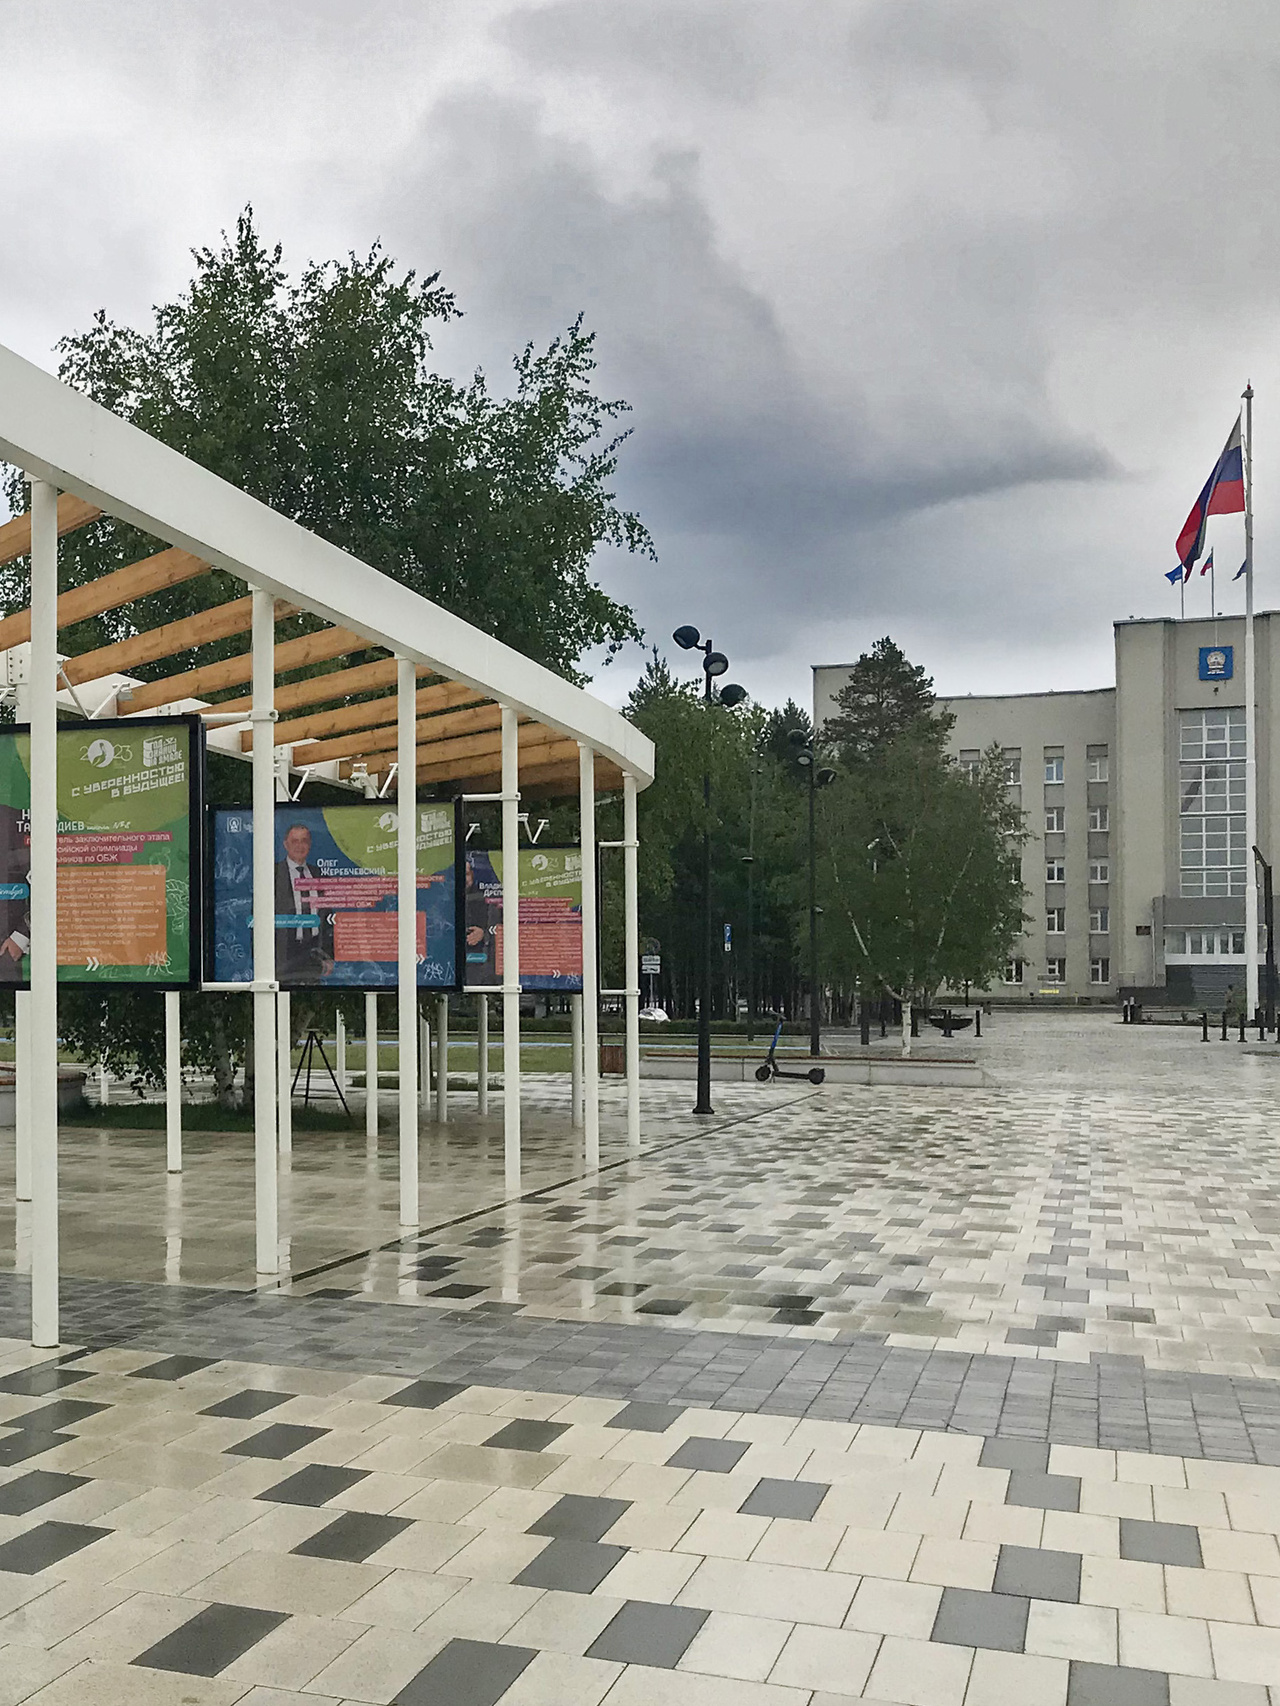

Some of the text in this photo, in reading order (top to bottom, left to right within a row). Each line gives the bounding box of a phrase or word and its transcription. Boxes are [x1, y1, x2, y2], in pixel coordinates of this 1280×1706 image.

[71, 787, 80, 797] С
[83, 762, 185, 795] УВЕРЕННОСТЬЮ
[111, 772, 185, 798] В БУДУЩЕЕ!
[74, 834, 145, 844] заключительного
[85, 855, 95, 863] по
[96, 853, 119, 863] ОБЖ
